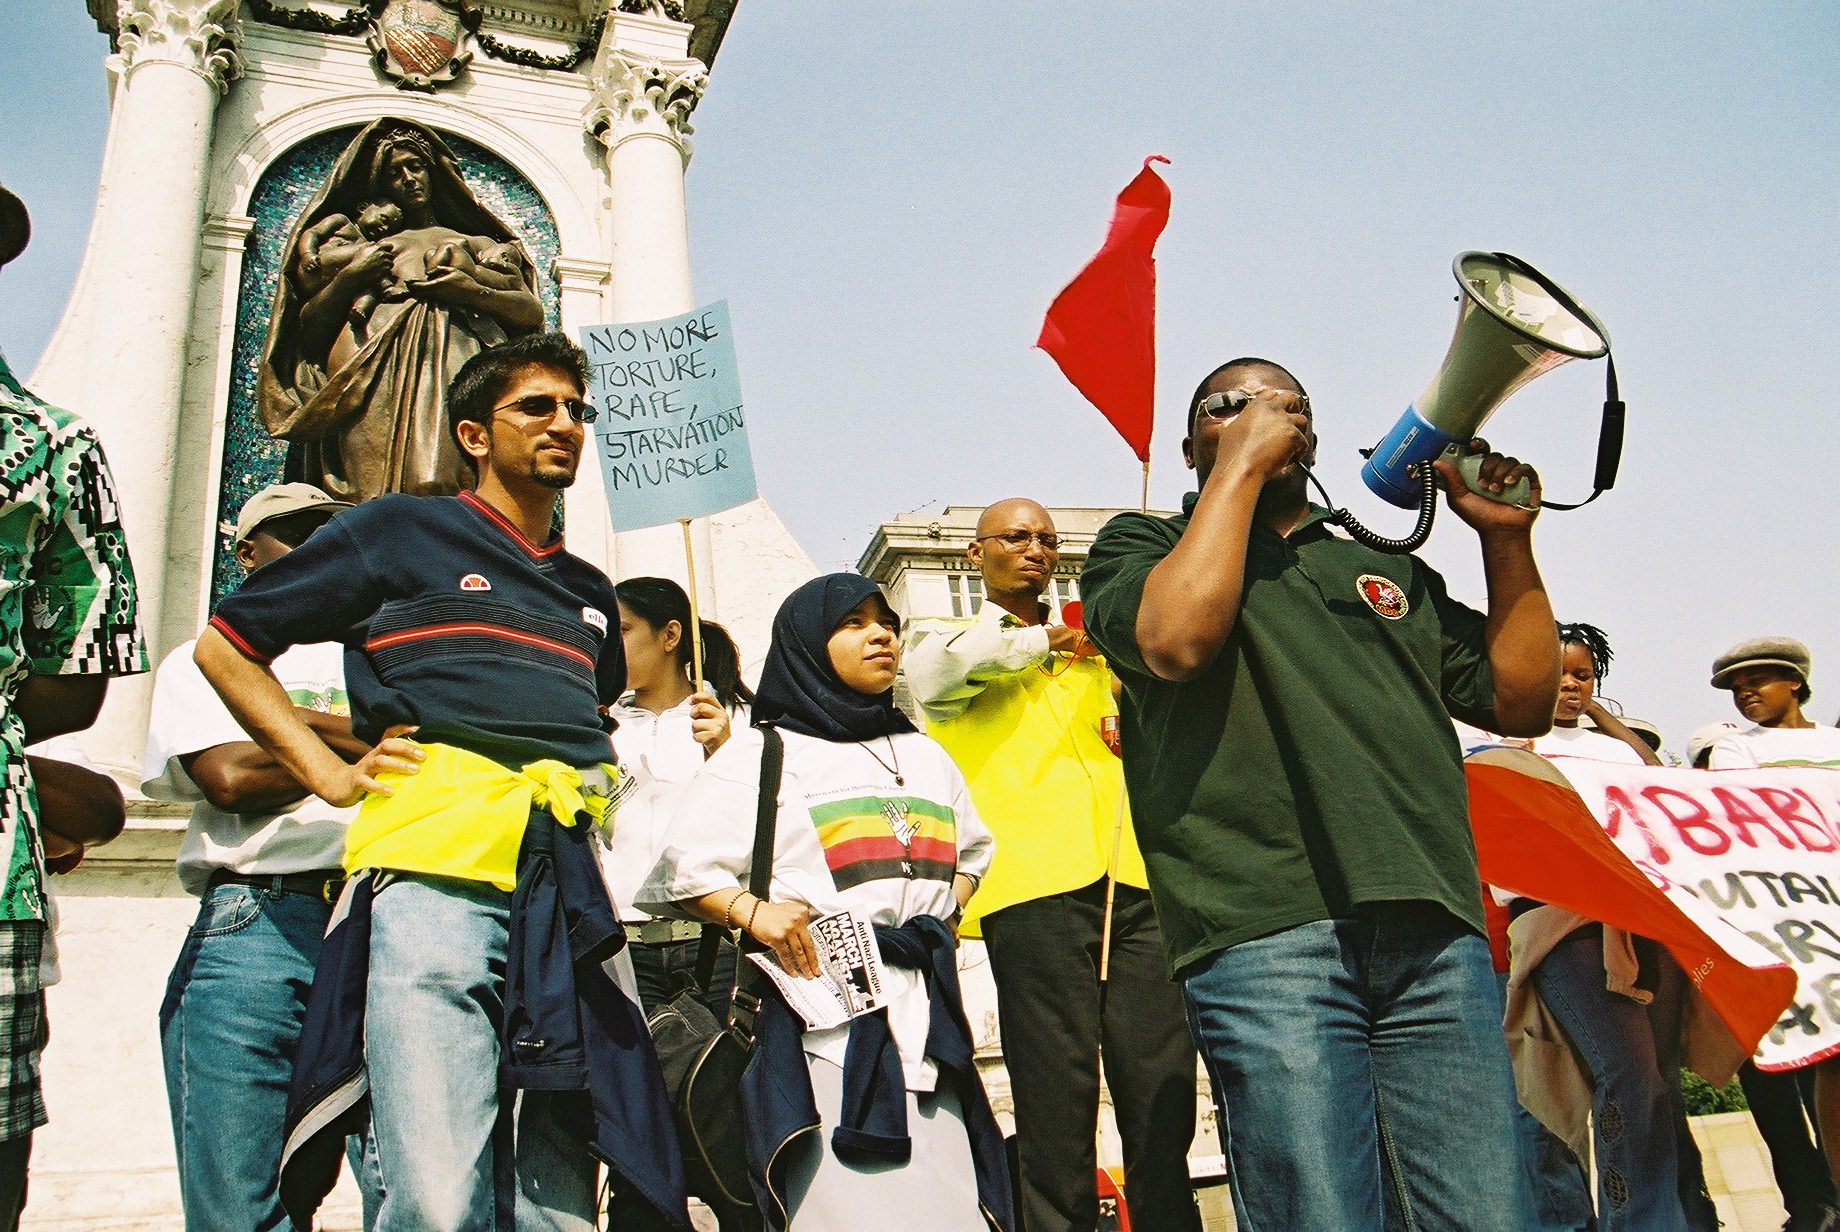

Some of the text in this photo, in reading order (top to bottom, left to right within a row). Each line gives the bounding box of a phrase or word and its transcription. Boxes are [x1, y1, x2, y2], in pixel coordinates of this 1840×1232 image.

[589, 311, 719, 354] NO MORE
[595, 349, 716, 390] TORTURE,
[598, 405, 744, 459] STARVATION
[613, 448, 729, 491] MURDER
[829, 920, 854, 980] AGAINST
[836, 912, 864, 969] MARCH
[857, 921, 882, 994] Anti Nazi League
